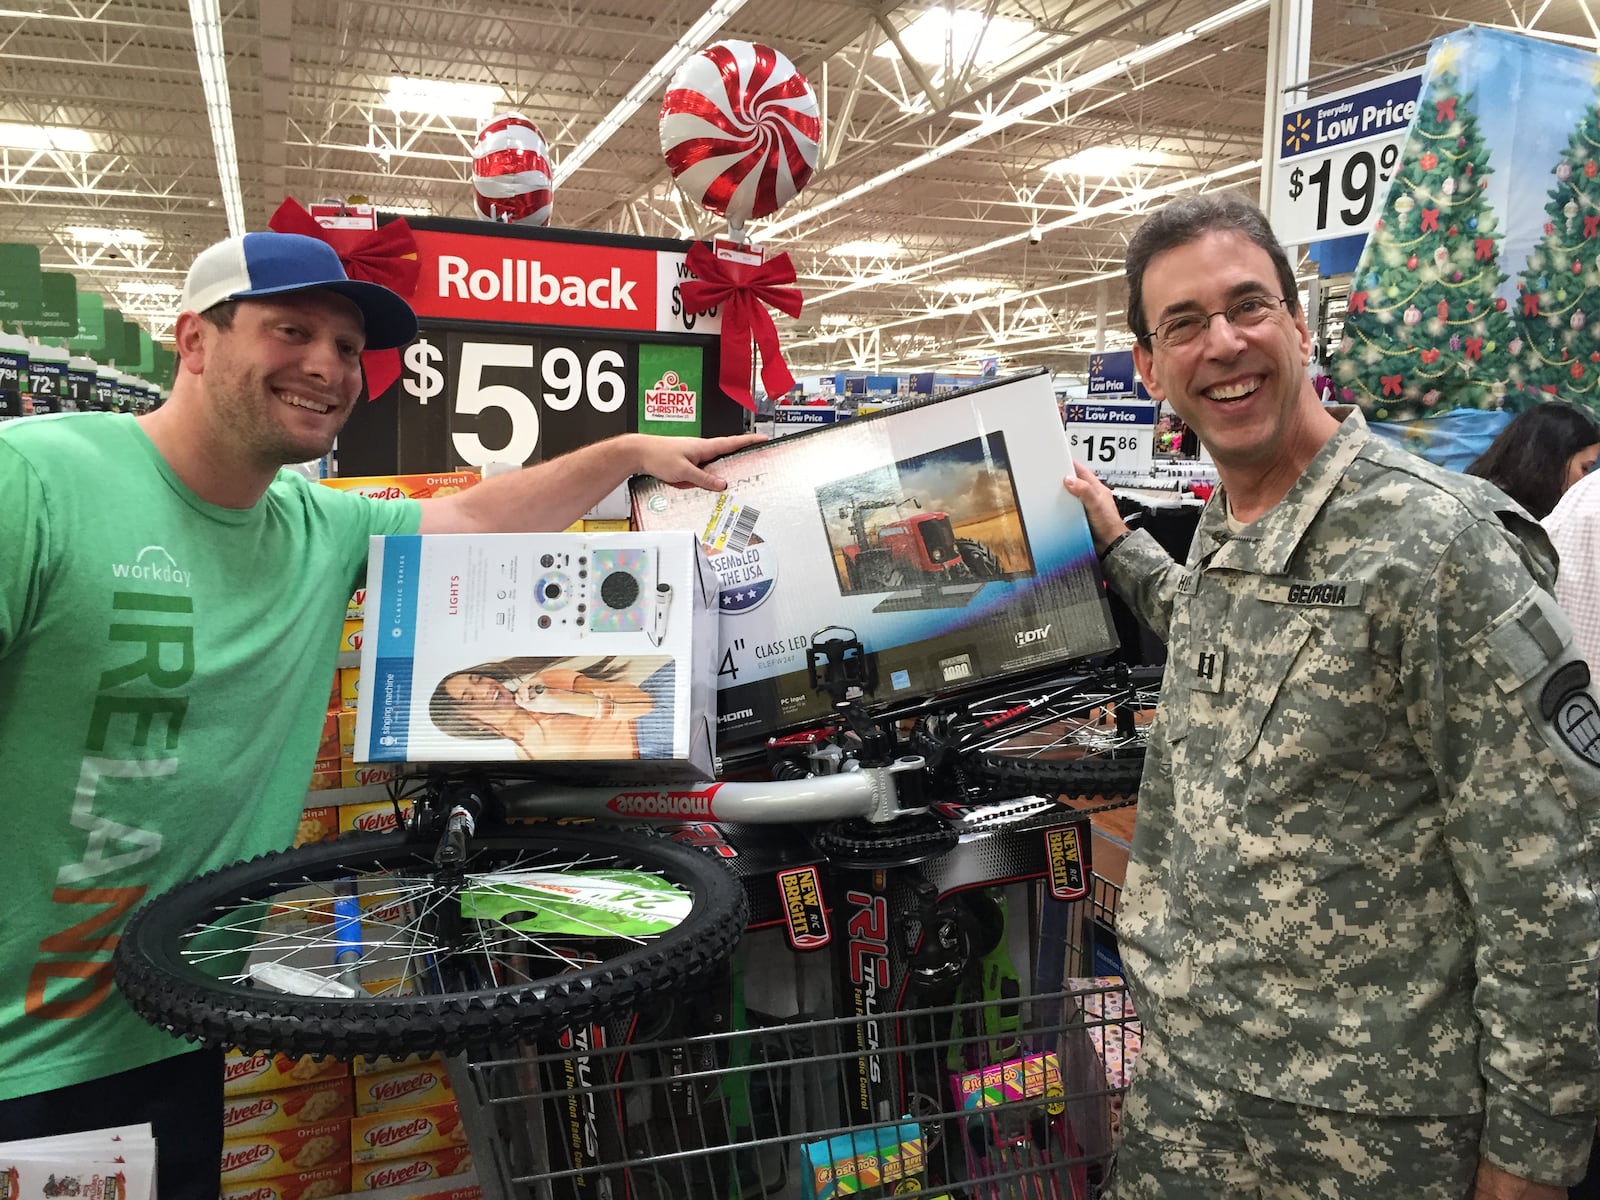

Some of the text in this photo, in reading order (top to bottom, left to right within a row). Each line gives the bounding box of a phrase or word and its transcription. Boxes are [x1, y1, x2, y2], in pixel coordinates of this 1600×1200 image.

[1316, 98, 1416, 144] Low Price
[1317, 101, 1353, 120] Everyday
[437, 255, 638, 312] Rollback
[1090, 380, 1124, 392] Low Price
[646, 392, 695, 406] MERRY
[646, 405, 694, 414] CHRISTMAS
[787, 413, 803, 422] Low
[804, 414, 823, 422] Price
[1085, 410, 1136, 422] Low Price
[426, 475, 468, 486] Original
[112, 562, 191, 587] workday
[720, 566, 763, 586] THE USA
[449, 574, 460, 616] LIGHTS
[1287, 583, 1346, 604] GEORGIA
[755, 640, 786, 659] CLASS
[789, 635, 808, 651] LED
[381, 673, 395, 735] singing machine
[780, 694, 806, 705] PC Input
[717, 708, 754, 724] HDMI
[25, 591, 194, 1019] IRELAND
[616, 791, 710, 816] mongoose
[1062, 830, 1078, 862] NEW
[1049, 832, 1068, 886] BRIGHT
[782, 875, 809, 934] BRIGHT
[798, 871, 821, 929] NEW R/C
[854, 988, 863, 1006] Full
[860, 1075, 868, 1110] Control
[374, 1072, 433, 1100] Velveeta
[297, 1124, 341, 1138] Original
[370, 1118, 428, 1147] Velveeta
[572, 1121, 580, 1148] Radio
[299, 1167, 342, 1181] Original
[370, 1161, 428, 1189] Velveeta
